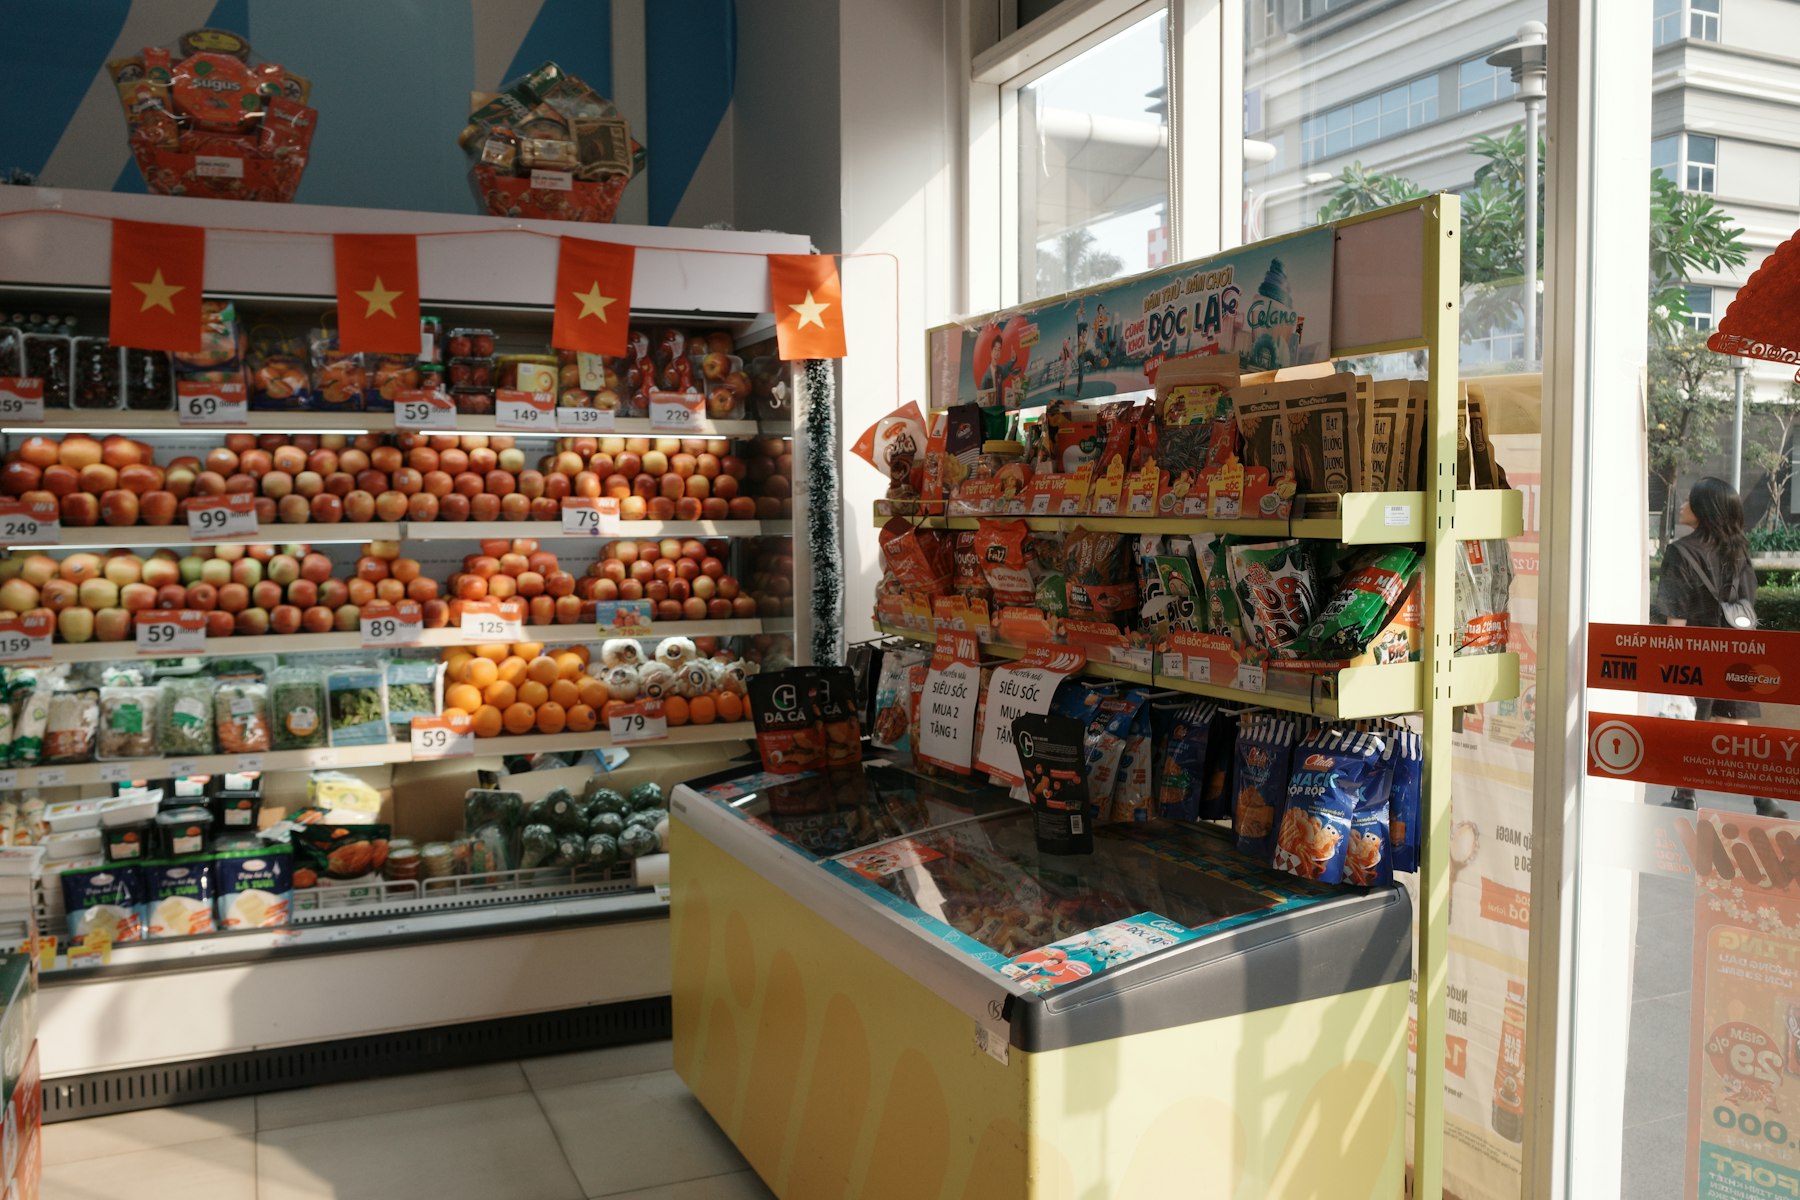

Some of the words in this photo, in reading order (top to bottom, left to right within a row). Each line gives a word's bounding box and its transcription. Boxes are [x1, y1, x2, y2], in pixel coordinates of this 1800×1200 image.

[192, 78, 241, 92] sugus
[1148, 304, 1188, 347] ĐỘC
[1194, 293, 1221, 342] LẠ
[189, 397, 216, 416] 69
[404, 403, 430, 421] 59
[513, 409, 538, 421] 149
[666, 409, 690, 421] 229
[574, 410, 598, 422] 139
[200, 510, 227, 529] 99
[576, 510, 600, 527] 79
[6, 521, 38, 536] 249
[147, 625, 175, 643] 59
[370, 619, 396, 637] 89
[479, 622, 504, 633] 125
[1, 638, 31, 652] 159
[1615, 632, 1647, 648] CHẤP
[1649, 634, 1684, 652] NHẬN
[1686, 639, 1729, 653] THANH
[1731, 639, 1766, 655] TOÁN
[1600, 660, 1637, 680] ATM
[1659, 663, 1703, 686] VISA
[1725, 672, 1781, 685] MasterCard
[1248, 674, 1257, 684] 12
[932, 680, 949, 695] SIÊU
[951, 680, 968, 699] SỐC
[1000, 680, 1019, 697] SIÊU
[1019, 682, 1040, 702] SỐC
[764, 712, 785, 724] DA
[932, 703, 952, 717] MUA
[953, 707, 959, 719] 2
[1000, 704, 1021, 720] MUA
[622, 715, 646, 732] 79
[930, 722, 951, 738] TẶNG
[422, 731, 447, 748] 59
[996, 726, 1014, 744] TẶN
[1711, 734, 1771, 759] CHÚ
[1780, 736, 1799, 762] Ý
[1683, 755, 1715, 766] KHÁCH
[1717, 758, 1744, 769] HÀNG
[1746, 762, 1759, 772] TỰ
[1762, 763, 1783, 773] BẢO
[1290, 771, 1340, 790] NACK
[1706, 767, 1718, 776] VÀ
[1720, 769, 1735, 778] TÀI
[1737, 770, 1757, 780] SẢN
[1758, 772, 1772, 782] CÁ
[1774, 776, 1800, 786] NHÂN
[1304, 785, 1326, 798] RỘP
